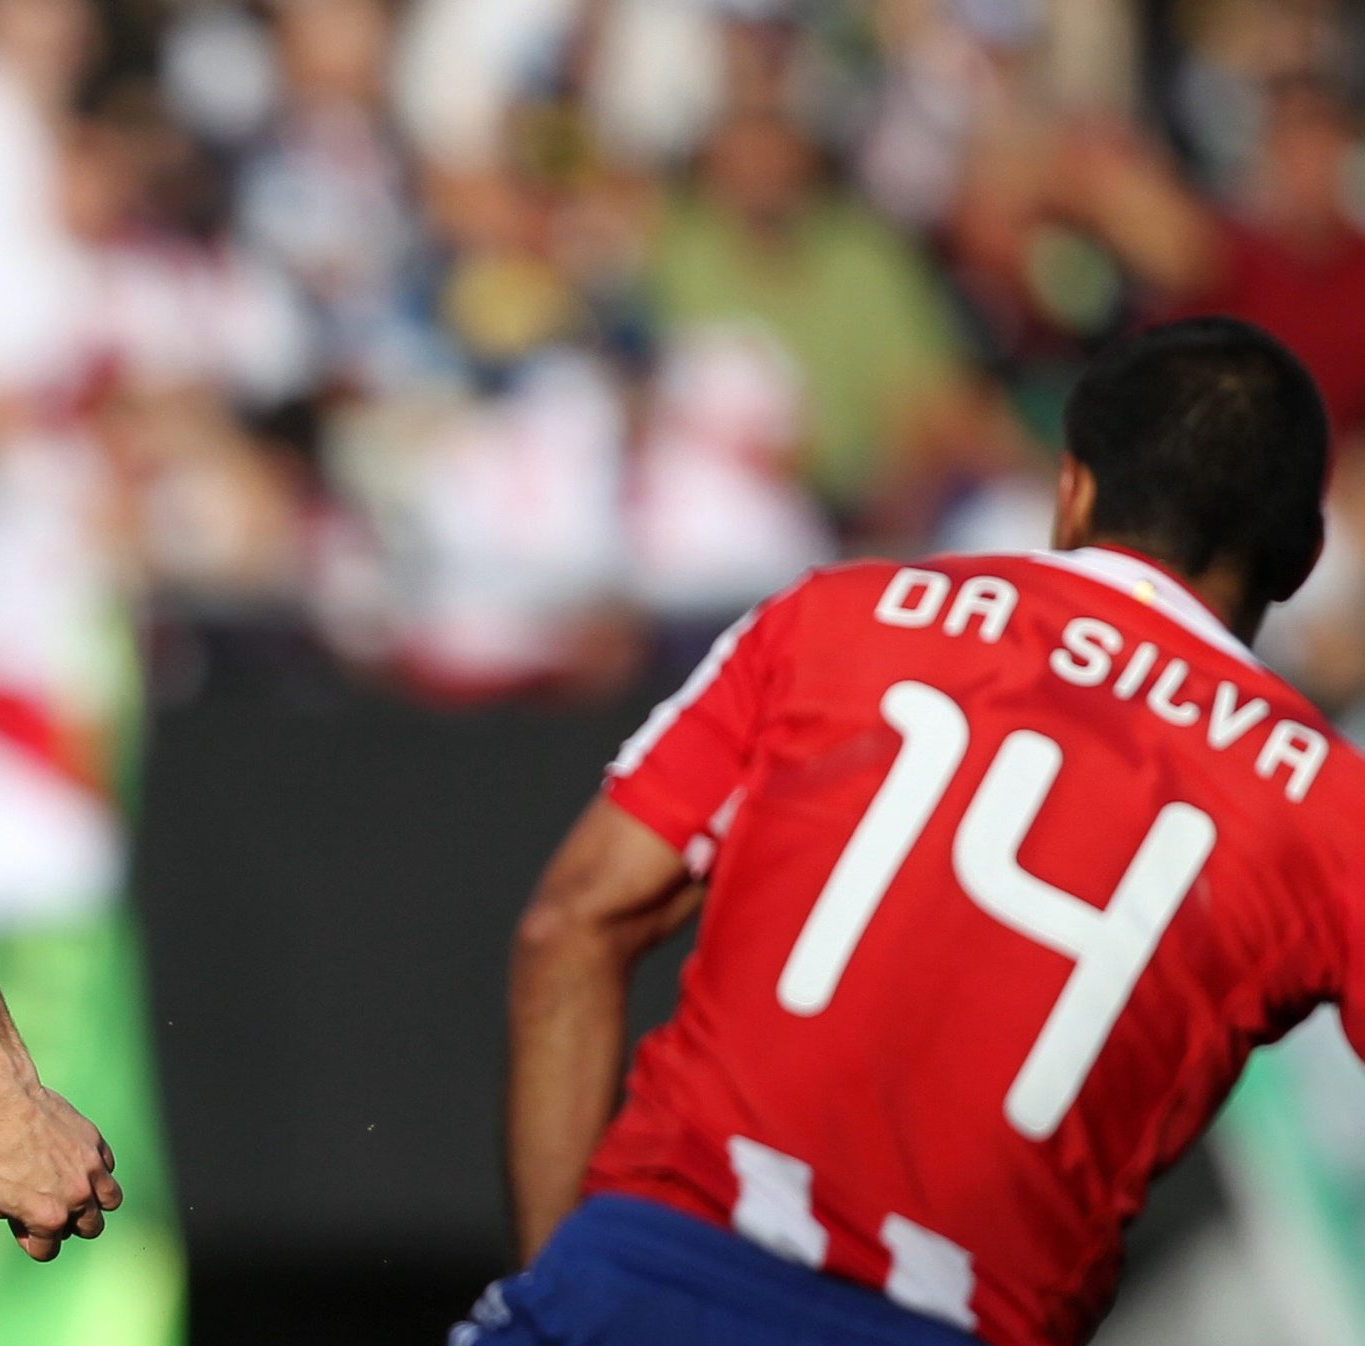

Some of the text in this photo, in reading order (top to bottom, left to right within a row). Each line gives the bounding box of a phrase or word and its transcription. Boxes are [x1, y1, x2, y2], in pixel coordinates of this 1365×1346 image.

[874, 567, 1329, 802] DA SILVA
[776, 679, 1218, 1141] 14
